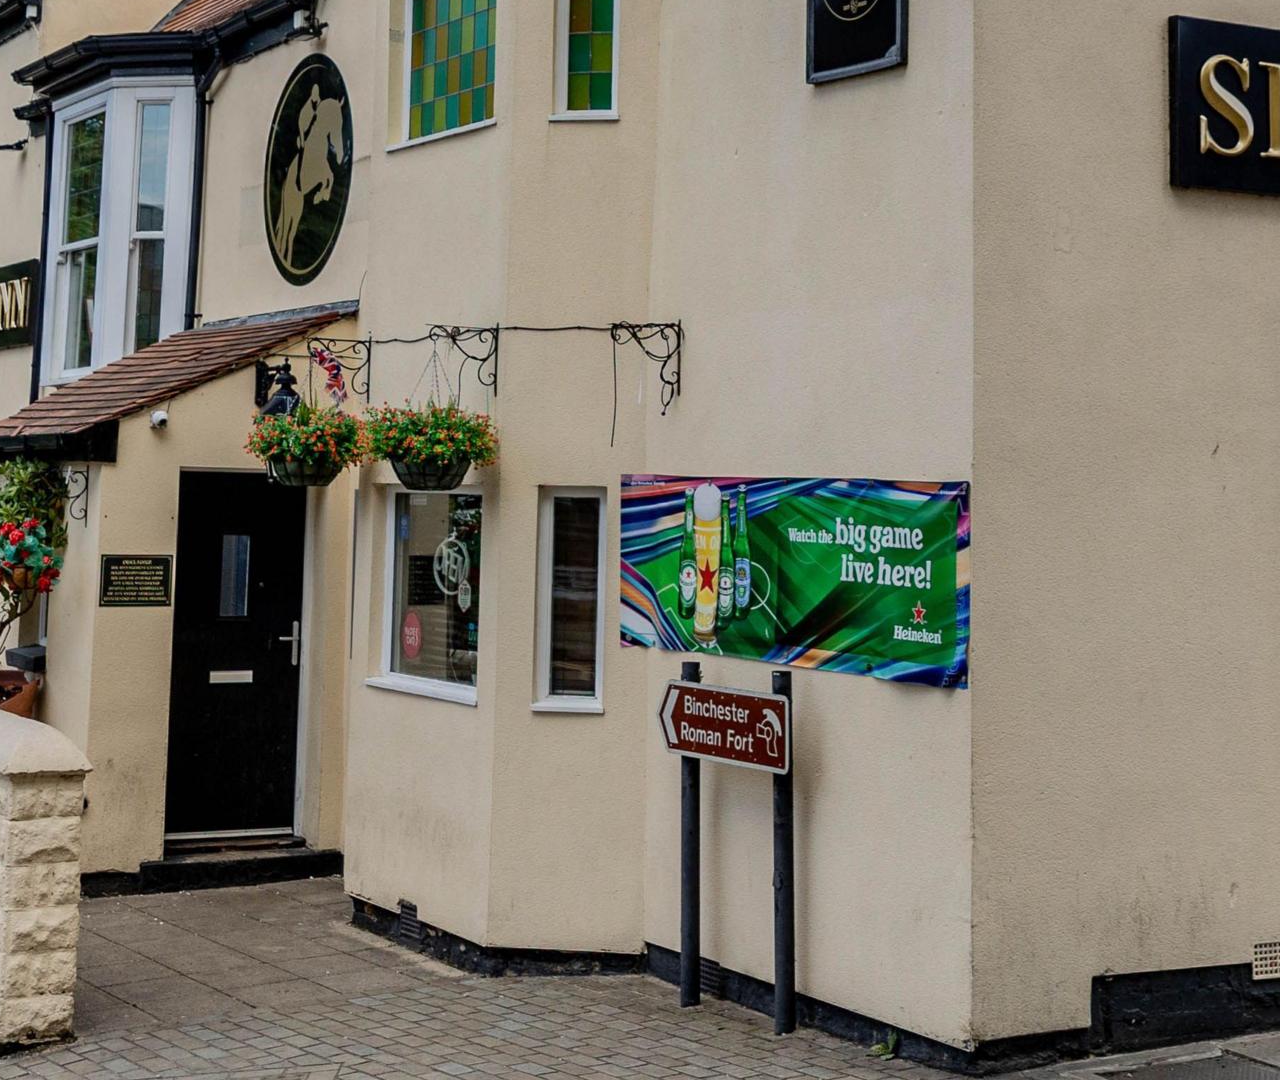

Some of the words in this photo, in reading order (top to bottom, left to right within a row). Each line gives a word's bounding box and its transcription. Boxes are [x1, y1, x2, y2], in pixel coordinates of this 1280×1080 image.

[788, 527, 817, 543] Watch
[818, 529, 833, 544] the
[835, 517, 867, 553] big
[870, 524, 924, 554] game
[840, 553, 874, 583] live
[877, 556, 932, 589] here!
[893, 624, 943, 645] Heineken
[684, 695, 750, 724] Binchester
[681, 721, 722, 747] Roman
[726, 728, 754, 753] Fort
